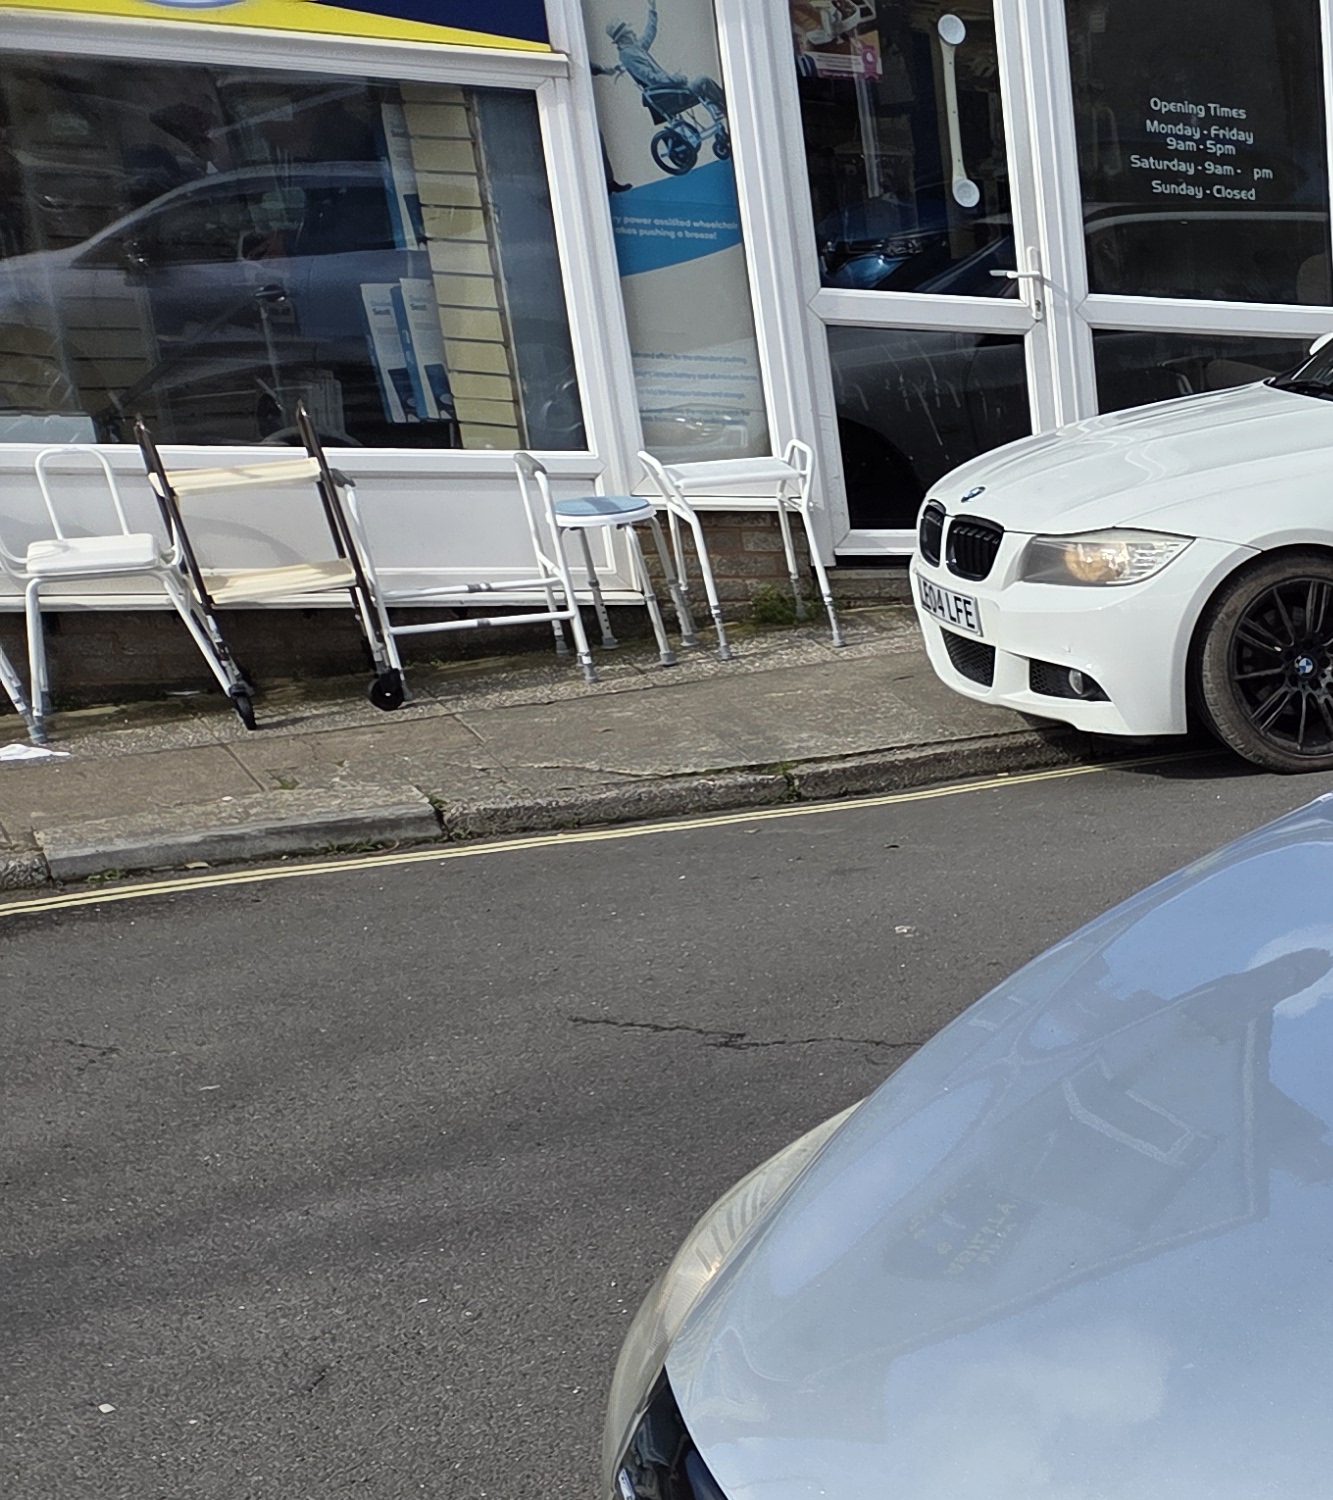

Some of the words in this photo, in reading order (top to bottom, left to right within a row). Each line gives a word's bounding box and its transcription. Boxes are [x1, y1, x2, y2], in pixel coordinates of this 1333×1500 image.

[1150, 97, 1206, 118] Opening
[1207, 103, 1247, 119] Times
[1146, 119, 1201, 139] Monday
[1210, 125, 1254, 144] Friday
[1166, 136, 1197, 151] 9am
[1206, 140, 1236, 156] 5pm
[1130, 154, 1195, 175] Saturday
[1204, 161, 1235, 176] 9am
[1253, 168, 1274, 181] pm
[1151, 180, 1204, 198] Sunday
[1213, 185, 1256, 200] Closed
[639, 228, 676, 239] pushing
[945, 592, 976, 629] LFE
